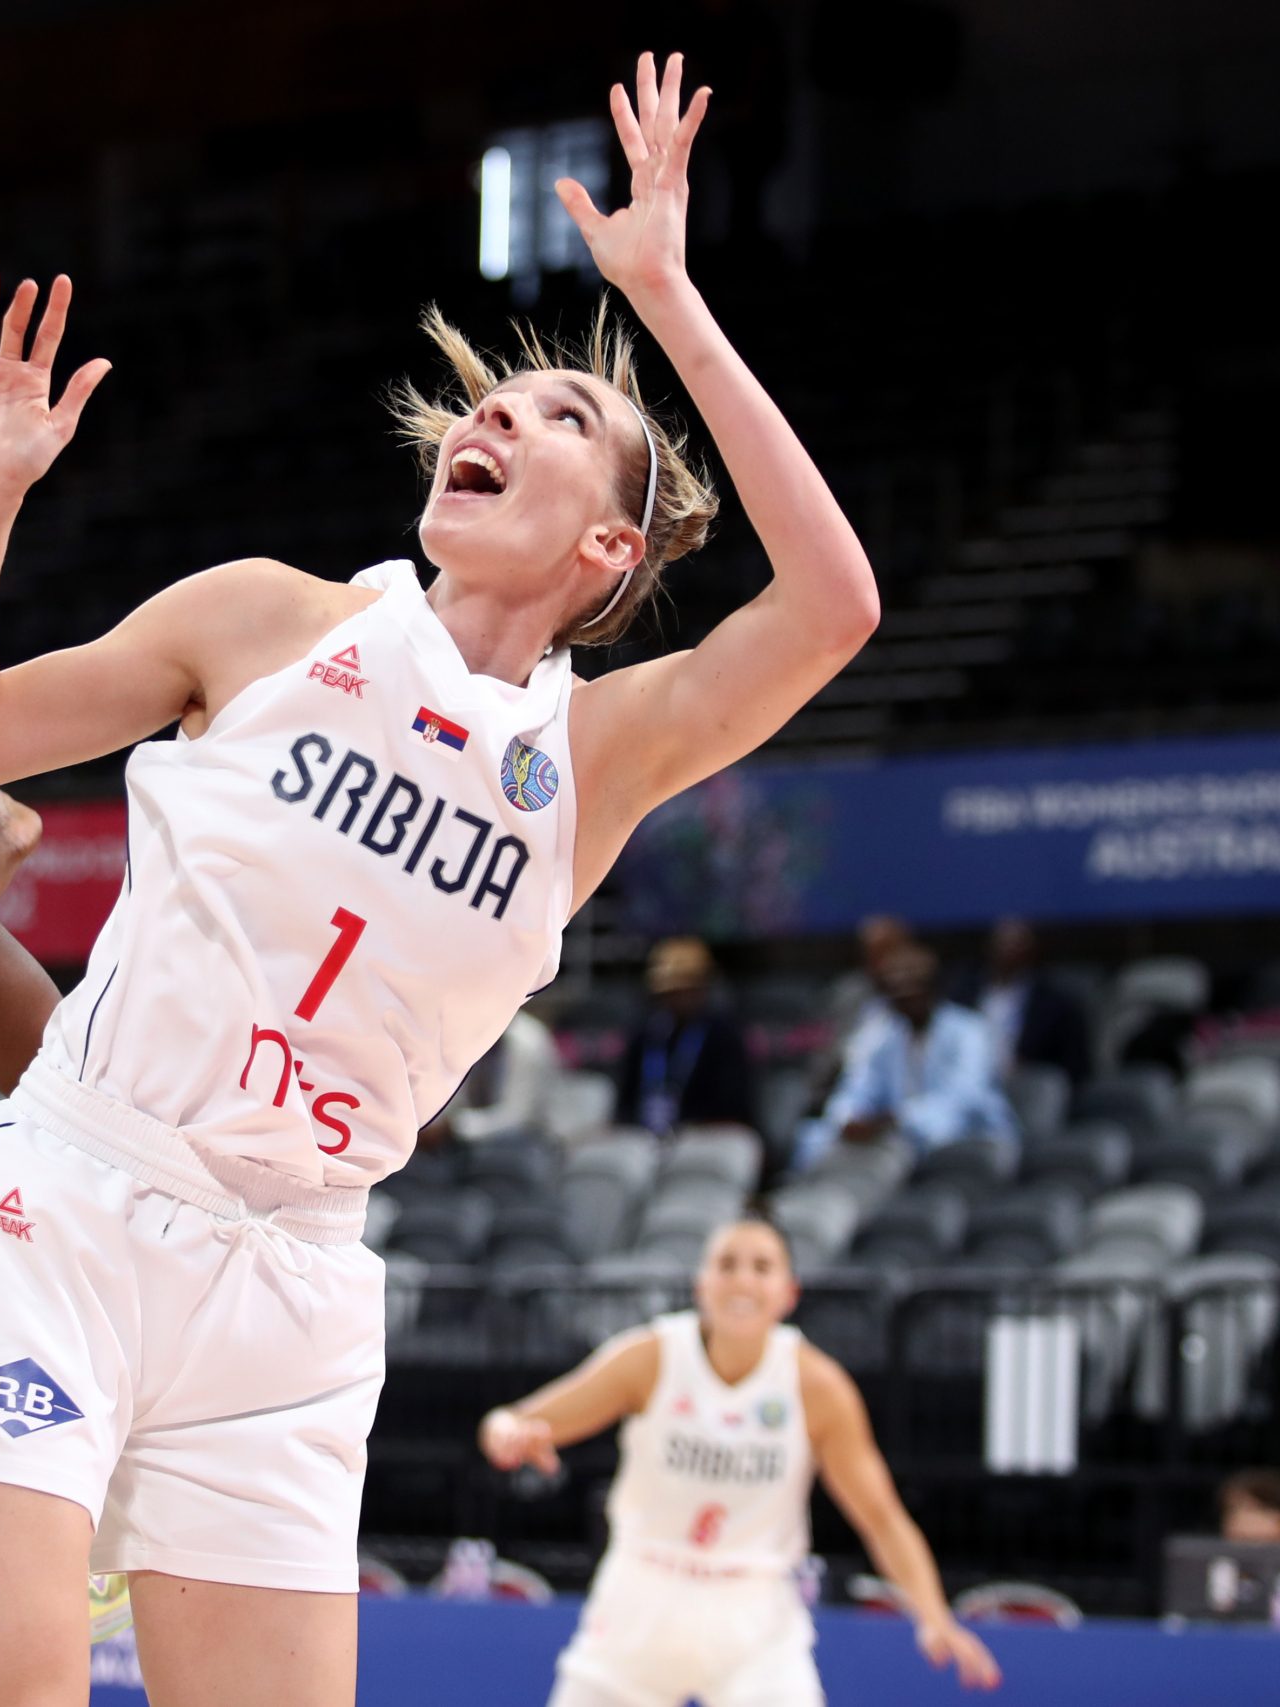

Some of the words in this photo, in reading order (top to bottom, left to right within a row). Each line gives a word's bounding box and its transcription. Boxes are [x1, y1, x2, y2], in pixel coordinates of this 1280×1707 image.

[306, 660, 370, 700] PEAK
[271, 731, 530, 922] SRBIJA
[294, 906, 367, 1022] 1
